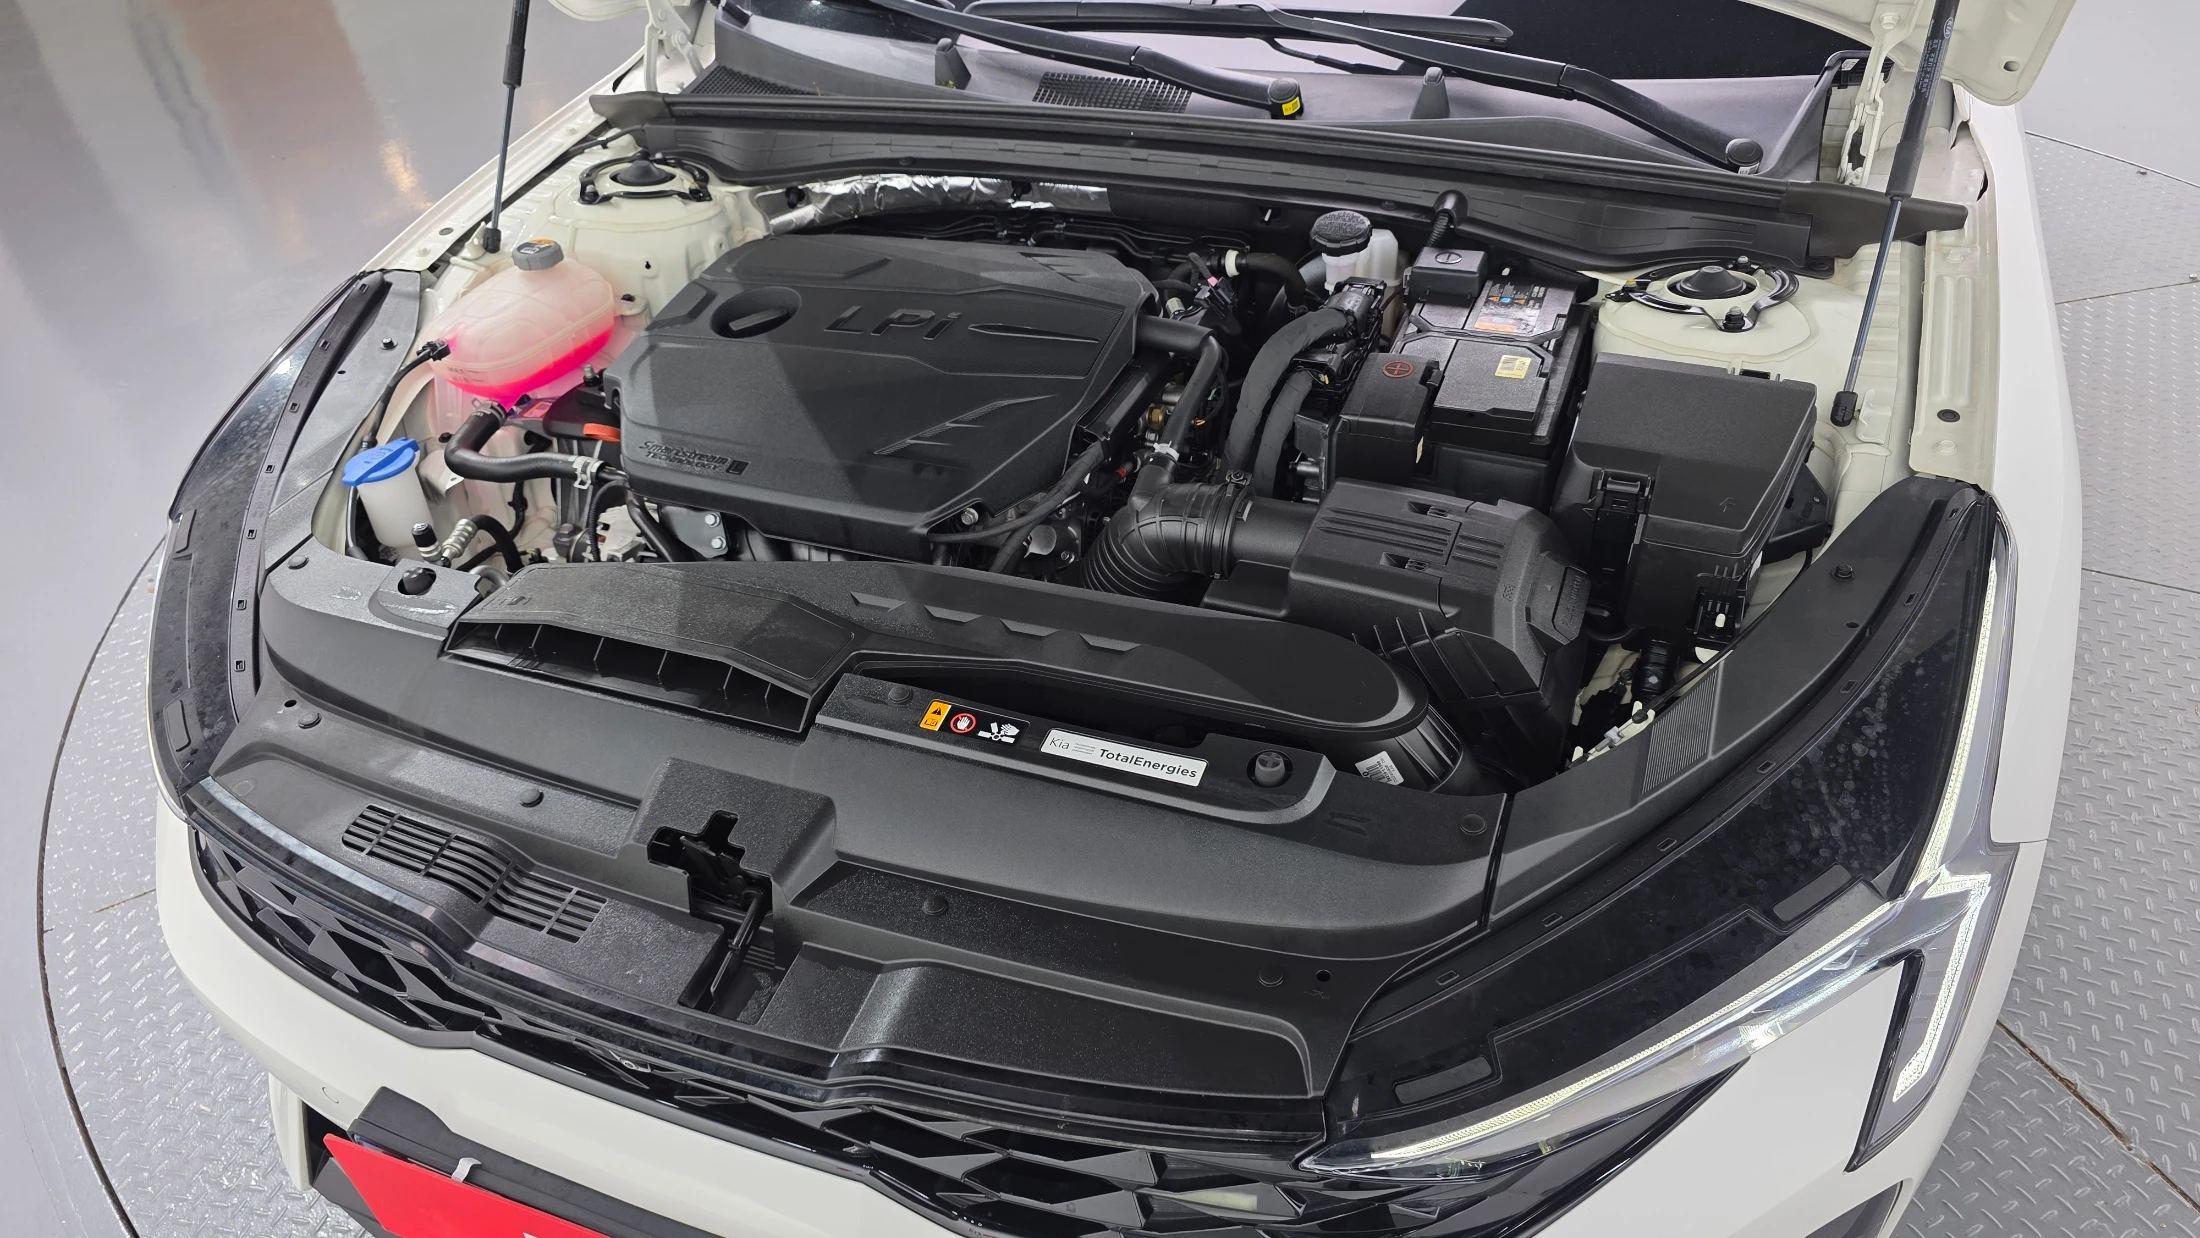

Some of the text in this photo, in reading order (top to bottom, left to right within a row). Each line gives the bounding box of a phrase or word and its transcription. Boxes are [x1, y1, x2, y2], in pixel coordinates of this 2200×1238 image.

[823, 305, 962, 341] LPi
[1049, 737, 1070, 750] Kia
[1099, 748, 1198, 778] TotalEnergies
